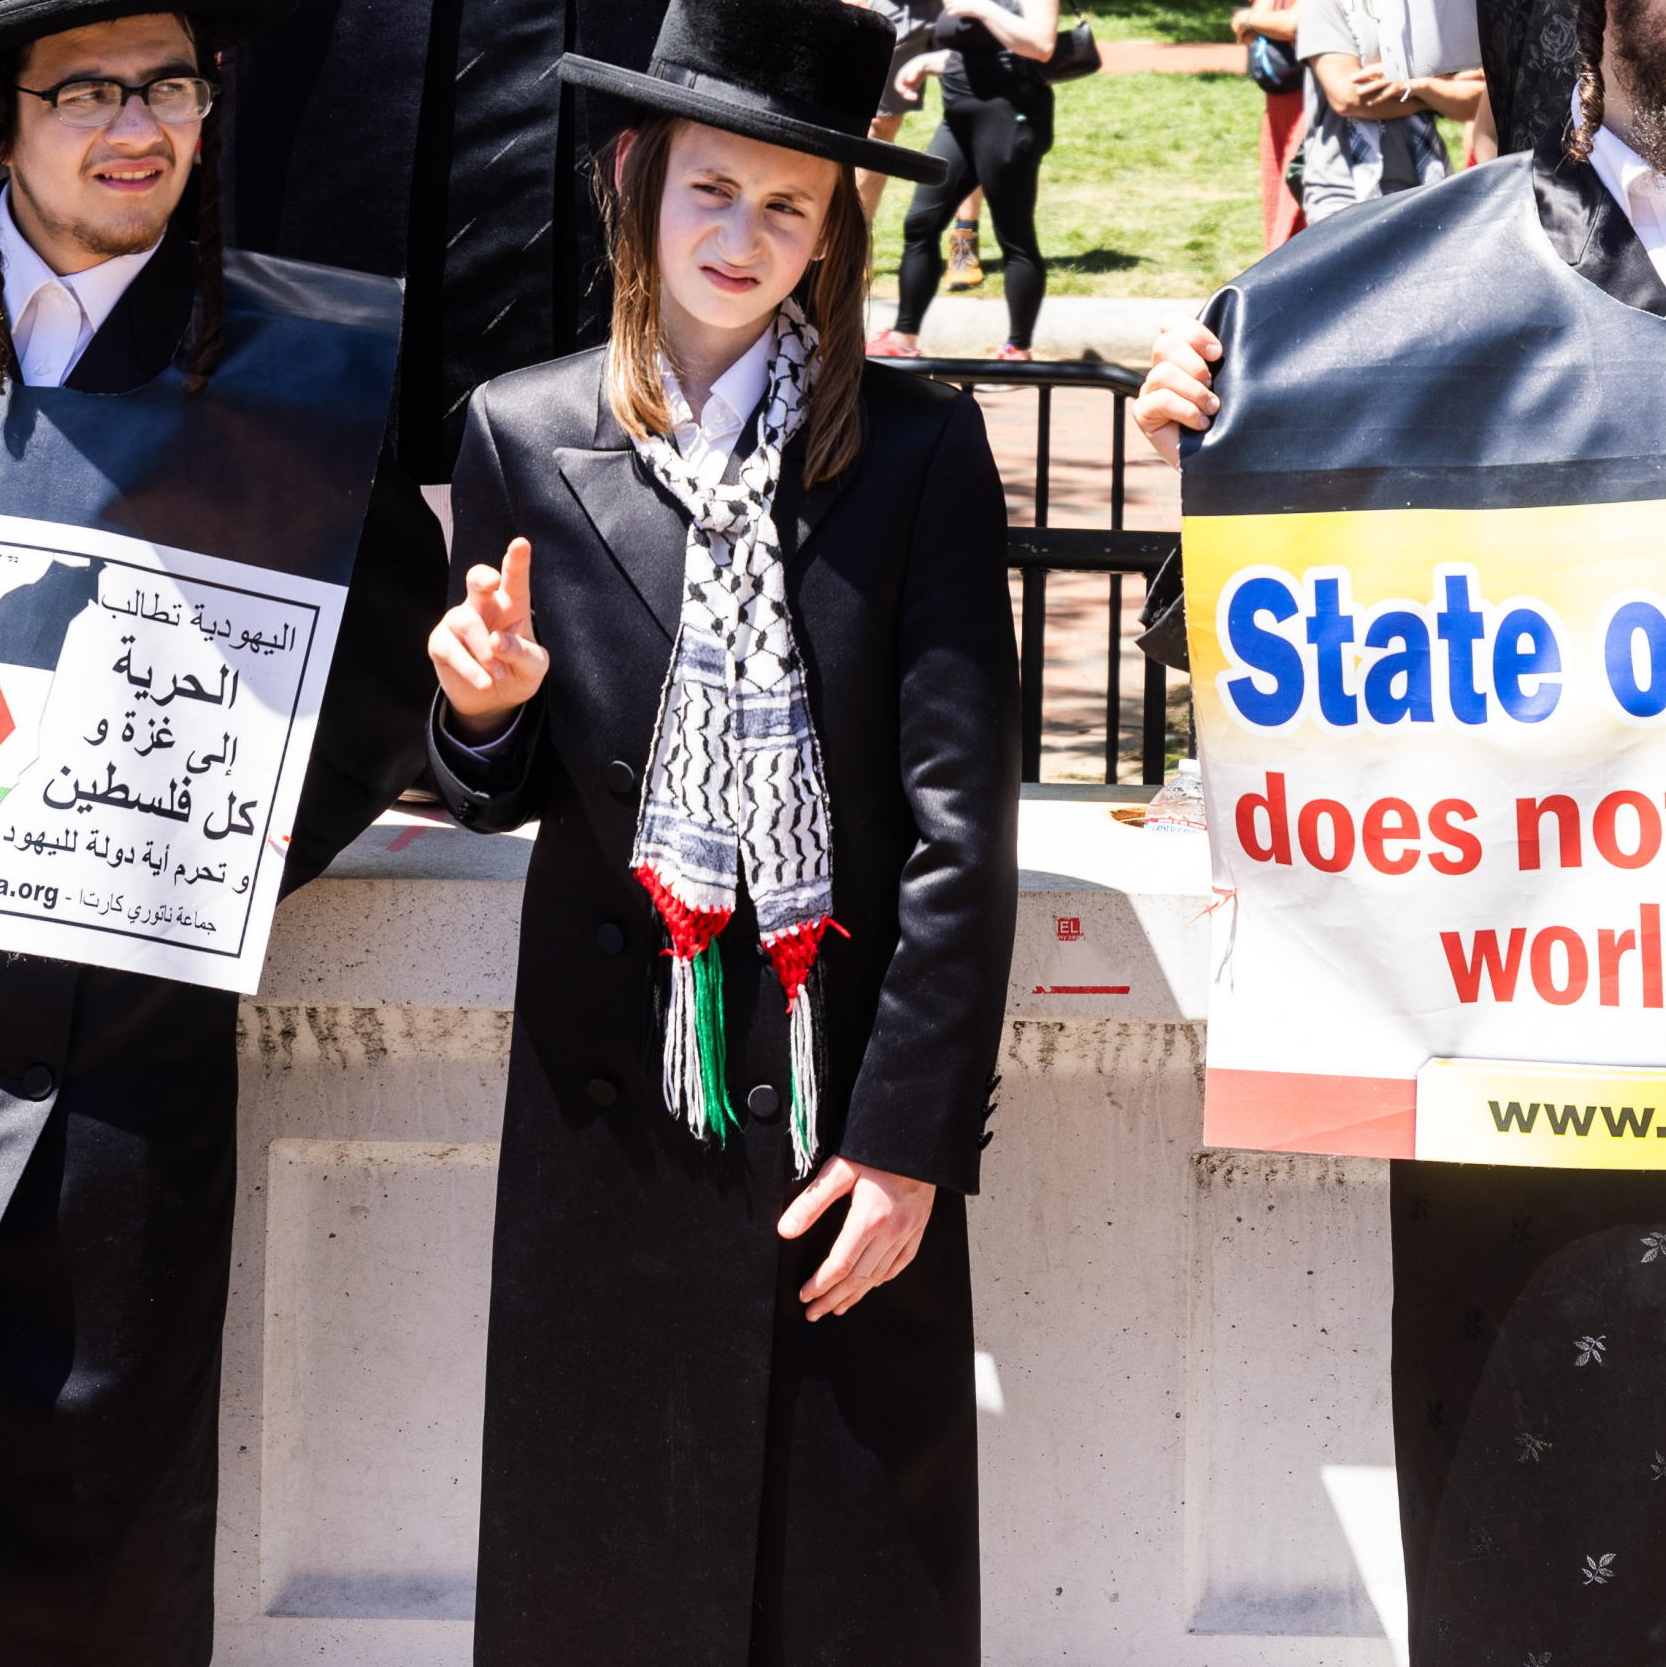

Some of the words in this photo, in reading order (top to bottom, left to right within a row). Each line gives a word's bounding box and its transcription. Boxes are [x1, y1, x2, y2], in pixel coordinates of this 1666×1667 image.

[101, 589, 182, 627] تطالب
[112, 635, 239, 709] الحرية
[1226, 574, 1563, 728] State
[121, 711, 176, 757] غزة
[186, 731, 238, 776] إلى
[43, 761, 192, 823] فلسطين
[203, 790, 258, 840] كل
[1235, 770, 1482, 875] does
